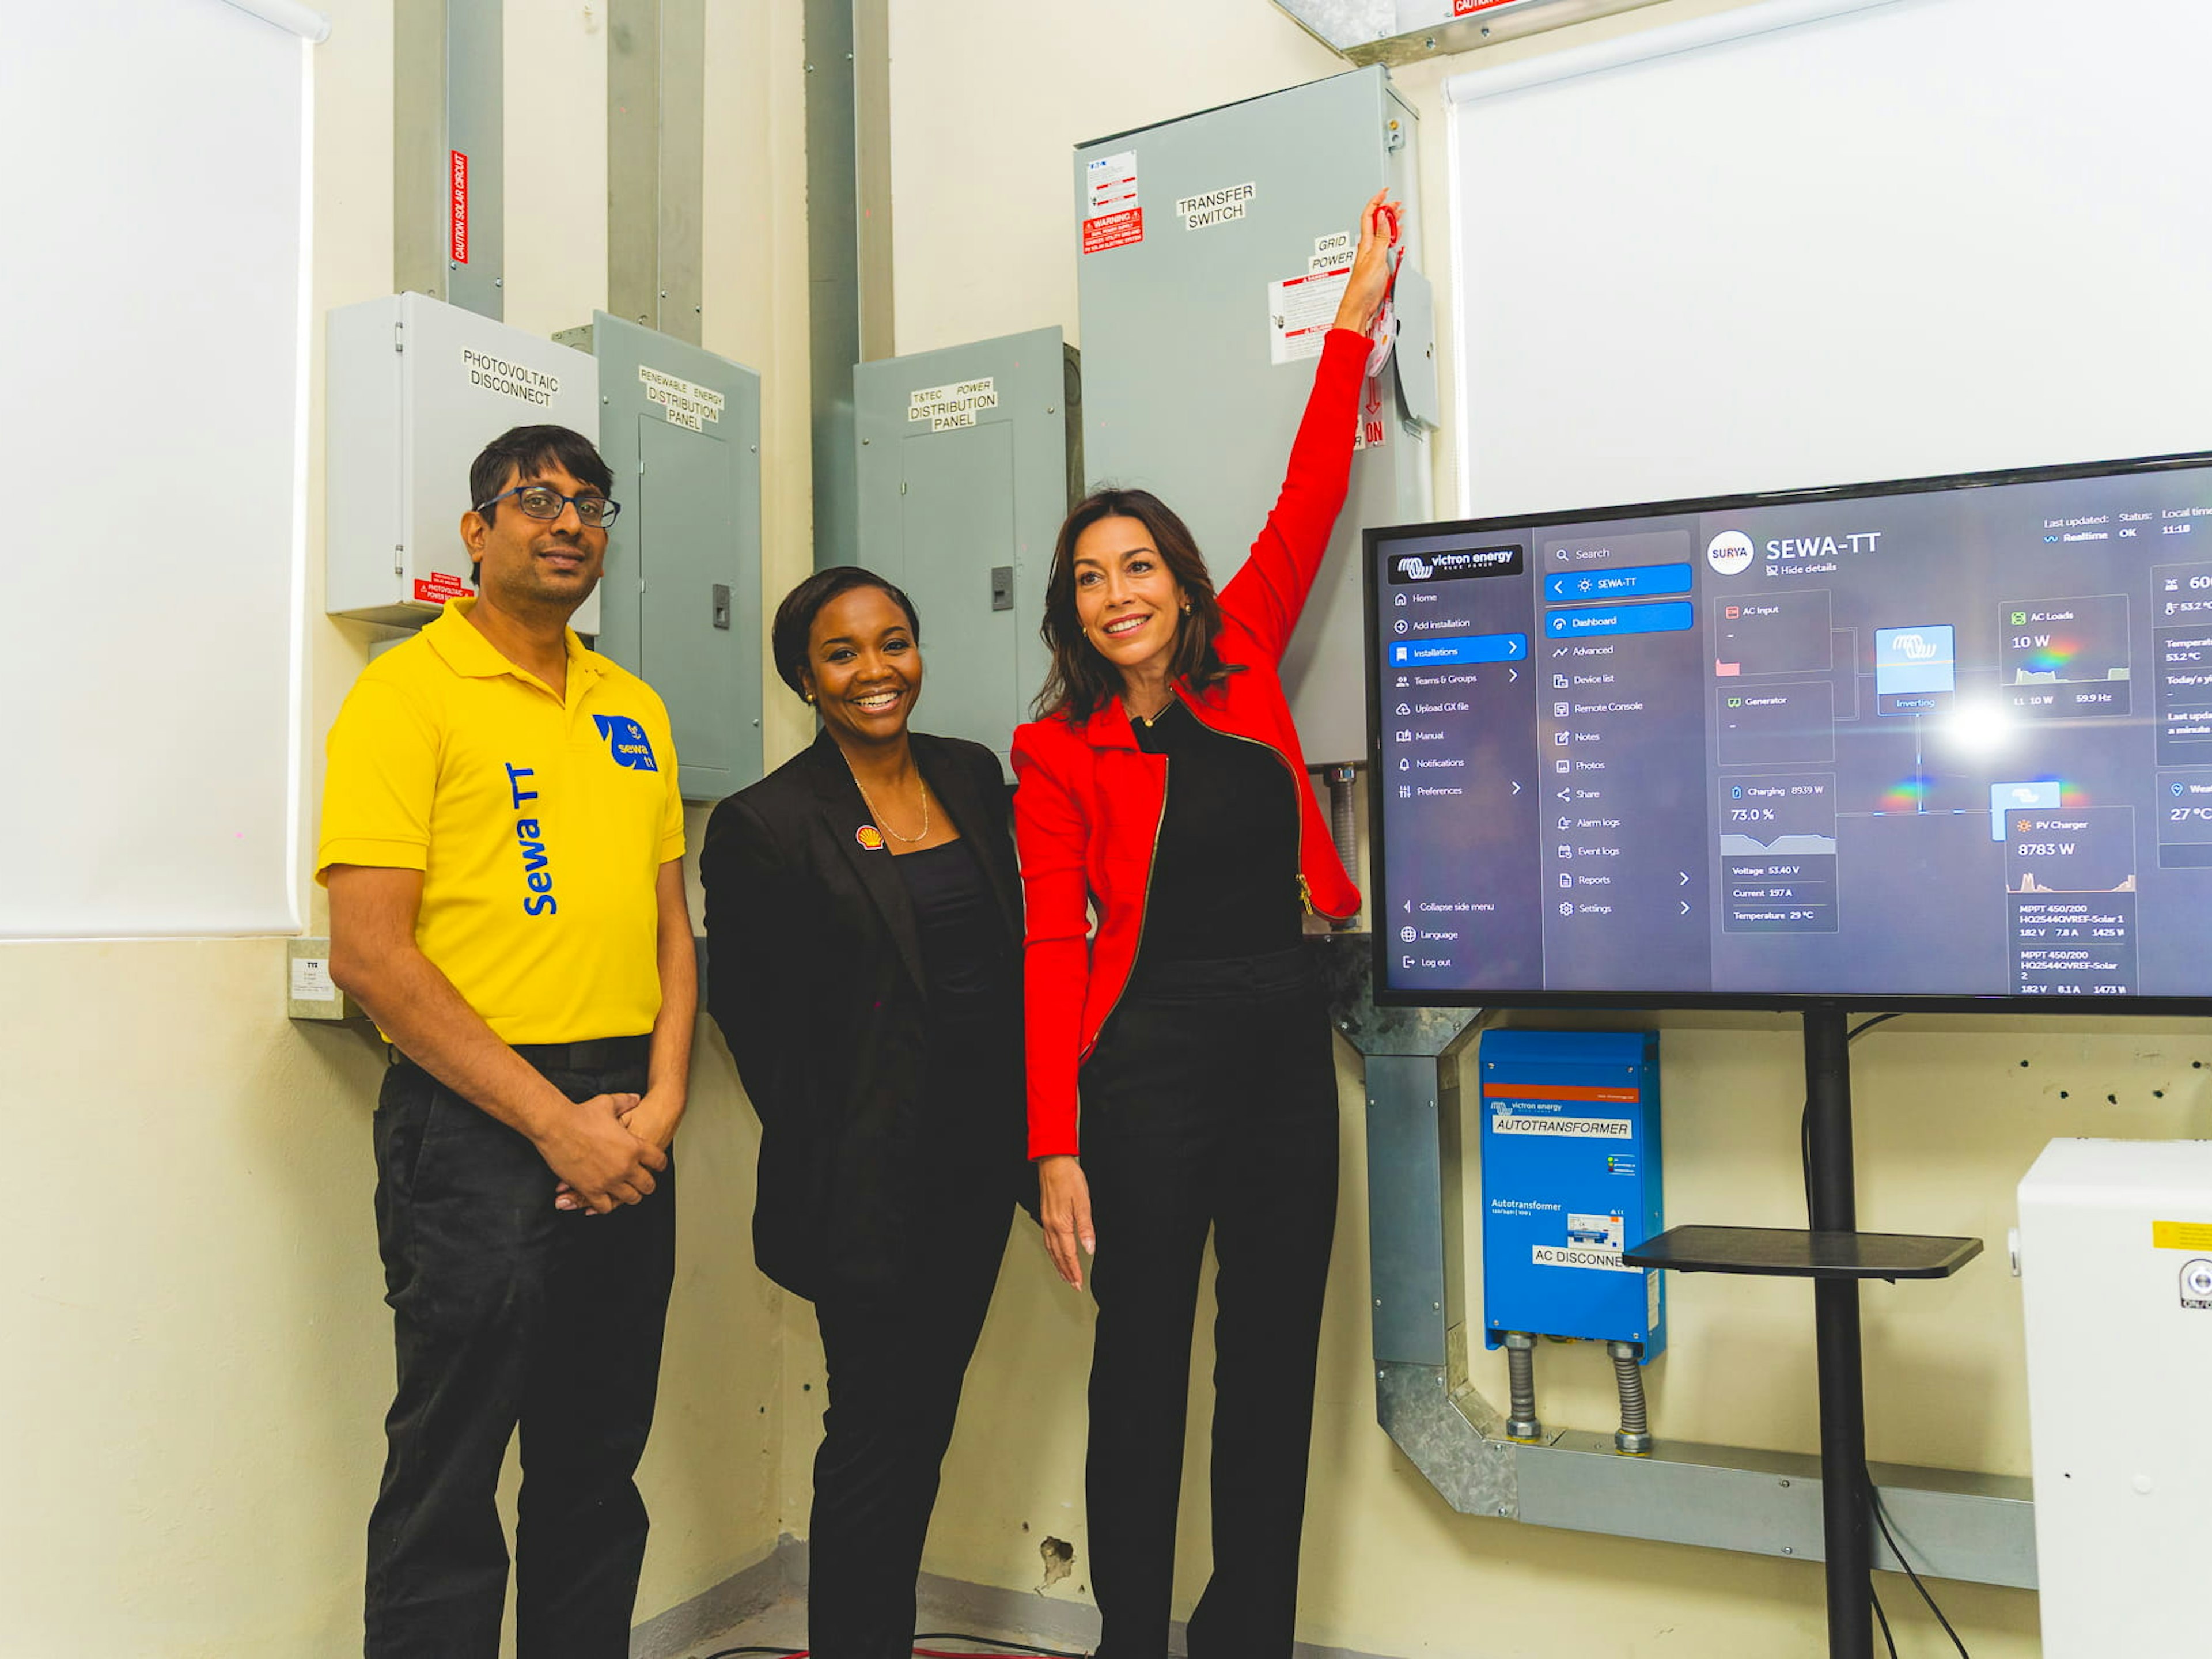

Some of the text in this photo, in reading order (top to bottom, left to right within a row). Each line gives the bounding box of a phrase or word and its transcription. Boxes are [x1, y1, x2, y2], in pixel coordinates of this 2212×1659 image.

[1179, 185, 1253, 214] TRANSFER
[454, 154, 465, 259] CAUTION SOLAR CIRCUIT
[1094, 212, 1131, 228] WARNING
[1189, 204, 1243, 228] SWITCH
[1319, 236, 1346, 251] GRID
[1312, 251, 1353, 269] POWER
[464, 350, 559, 392] PHOTOVOLTAIC
[471, 370, 551, 407] DISCONNECT
[641, 369, 722, 405] RENEWABLE ENERGY
[914, 381, 991, 403] T&TEC POWER
[648, 387, 717, 421] DISTRIBUTION
[911, 395, 995, 419] DISTRIBUTION
[668, 410, 700, 430] PANEL
[934, 414, 974, 429] PANEL
[1366, 421, 1382, 442] ON
[2119, 512, 2153, 522] Status:
[2162, 507, 2190, 518] Local
[2044, 514, 2109, 528] Last updated:
[2063, 532, 2108, 542] Realtime
[2119, 529, 2137, 538] OK
[1766, 532, 1881, 560] SEWA-TT
[1431, 551, 1513, 566] victron energy
[1576, 548, 1609, 560] Search
[1712, 547, 1748, 559] SURYA
[1781, 563, 1837, 575] Hide details
[1598, 578, 1636, 589] SEWA-TT
[2190, 576, 2212, 589] 60
[1413, 593, 1437, 603] Home
[1743, 605, 1779, 616] AC Input
[1573, 616, 1617, 628] Dashboard
[2031, 611, 2074, 622] AC Loads
[1413, 618, 1470, 630] Add installation
[2013, 635, 2050, 649] 10 W
[2165, 638, 2212, 649] Temperat
[1414, 647, 1458, 657] Installations
[1573, 645, 1614, 656] Advanced
[1415, 674, 1477, 685] Teams & Groups
[1574, 673, 1615, 684] Device list
[1745, 696, 1787, 706] Generator
[2031, 696, 2042, 706] 10
[2043, 695, 2054, 705] W
[2098, 693, 2112, 702] Hz
[1415, 702, 1469, 714] Upload GX file
[1575, 701, 1643, 713] Remote Console
[1897, 698, 1936, 709] Inverting
[1416, 730, 1444, 741] Manual
[2176, 726, 2210, 734] minute
[1575, 732, 1600, 742] Notes
[618, 744, 649, 755] sewa
[1416, 757, 1464, 768] Notifications
[1576, 760, 1605, 771] Photos
[1417, 786, 1463, 797] Preferences
[1577, 790, 1600, 800] Share
[1747, 786, 1824, 797] Charging 8939 W
[1731, 809, 1774, 821] 73.0 %
[2171, 808, 2191, 820] 27
[1577, 817, 1620, 829] Alarm logs
[2037, 820, 2088, 831] PV Charger
[505, 762, 557, 915] Sewa TT
[1578, 846, 1620, 857] Event logs
[2018, 843, 2075, 856] 8783 W
[1732, 866, 1800, 877] Voltage 53.40 V
[1578, 875, 1611, 886] Reports
[1733, 889, 1793, 897] Current 197 A
[1419, 901, 1494, 914] Collapse side menu
[1579, 904, 1612, 915] Settings
[2020, 905, 2088, 914] MPPT 450/200
[1733, 911, 1785, 921] Temperature
[1790, 911, 1801, 920] 29
[2118, 915, 2124, 923] 1
[1421, 930, 1459, 941] Language
[2038, 929, 2046, 937] V
[2071, 929, 2079, 937] A
[2116, 928, 2125, 937] W
[2021, 951, 2089, 959] MPPT 450/200
[1421, 958, 1451, 968] Log out
[2021, 972, 2028, 980] 2
[2039, 985, 2047, 994] V
[2073, 985, 2081, 994] A
[2118, 985, 2126, 994] W
[1512, 1101, 1536, 1109] victron
[1537, 1104, 1563, 1112] energy
[1497, 1119, 1628, 1135] AUTOTRANSFORMER
[1491, 1199, 1562, 1211] Autotransformer
[1536, 1251, 1639, 1268] AC DISCONNE
